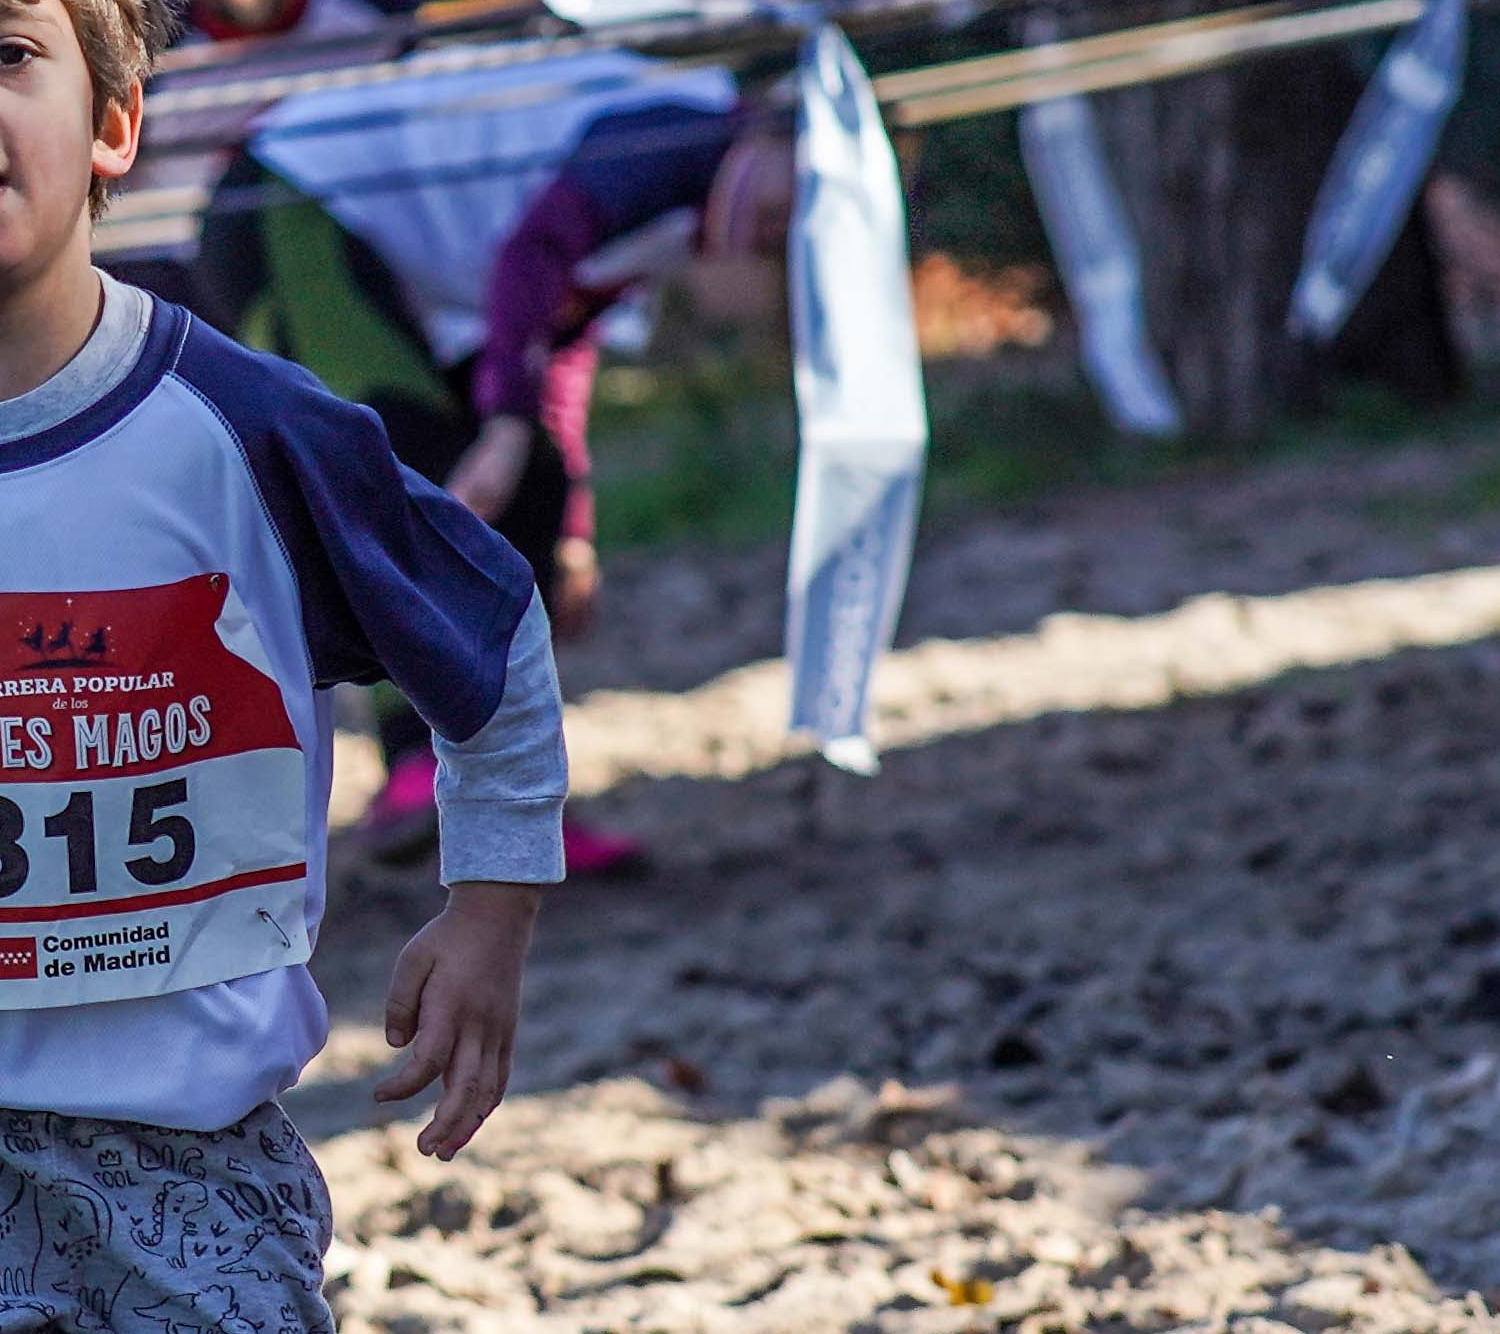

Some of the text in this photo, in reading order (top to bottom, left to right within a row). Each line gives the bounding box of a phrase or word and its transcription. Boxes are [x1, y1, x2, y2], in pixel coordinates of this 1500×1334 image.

[73, 671, 175, 693] POPULAR
[52, 697, 89, 710] de los
[72, 695, 211, 770] MAGOS
[42, 921, 170, 953] Comunidad
[44, 945, 171, 978] de Madrid
